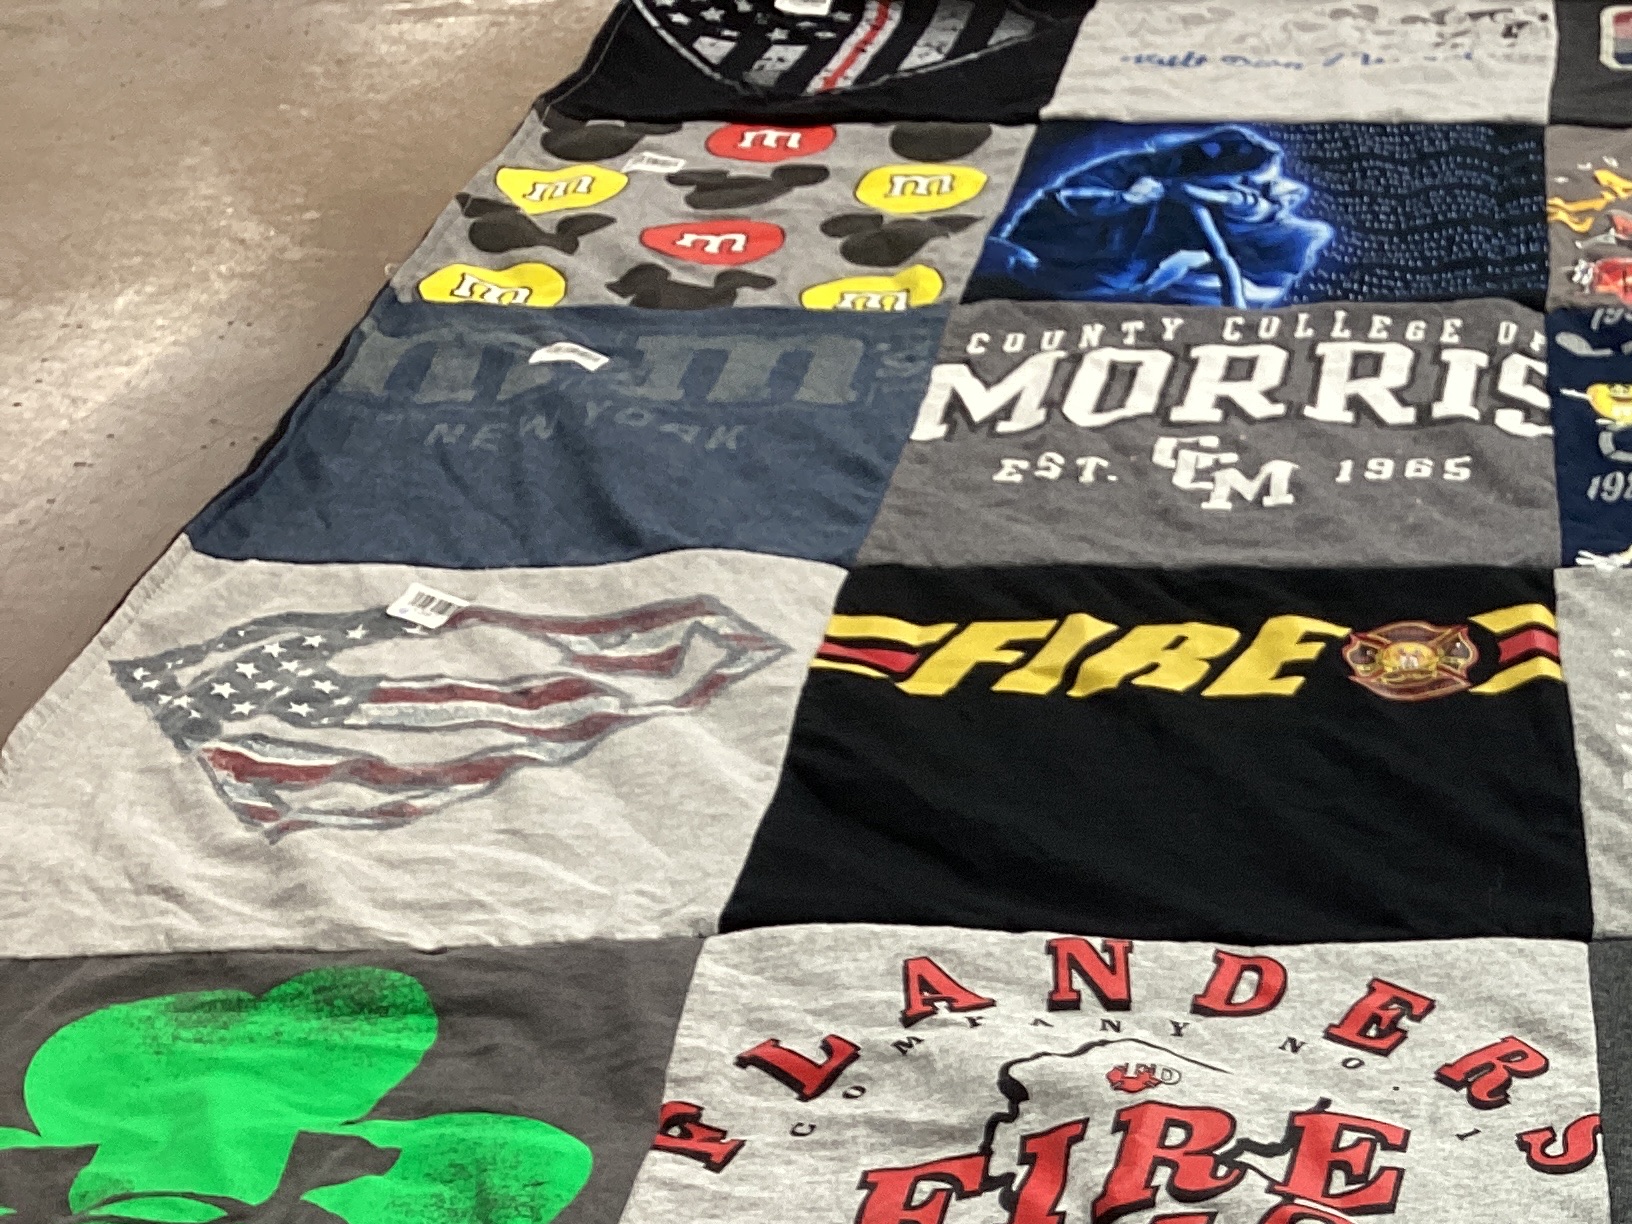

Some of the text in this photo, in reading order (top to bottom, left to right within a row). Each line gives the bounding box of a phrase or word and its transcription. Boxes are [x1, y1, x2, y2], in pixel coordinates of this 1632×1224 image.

[738, 128, 801, 150] m
[523, 176, 594, 202] m
[887, 173, 956, 197] m
[675, 232, 748, 255] m
[452, 274, 533, 304] m
[965, 317, 1185, 355] COUNTY
[1221, 310, 1465, 345] COLLEGE
[910, 341, 1554, 442] MORRIS
[993, 452, 1472, 484] EST. 1965
[894, 612, 1354, 697] FIRE
[654, 936, 1604, 1176] FLANDERS
